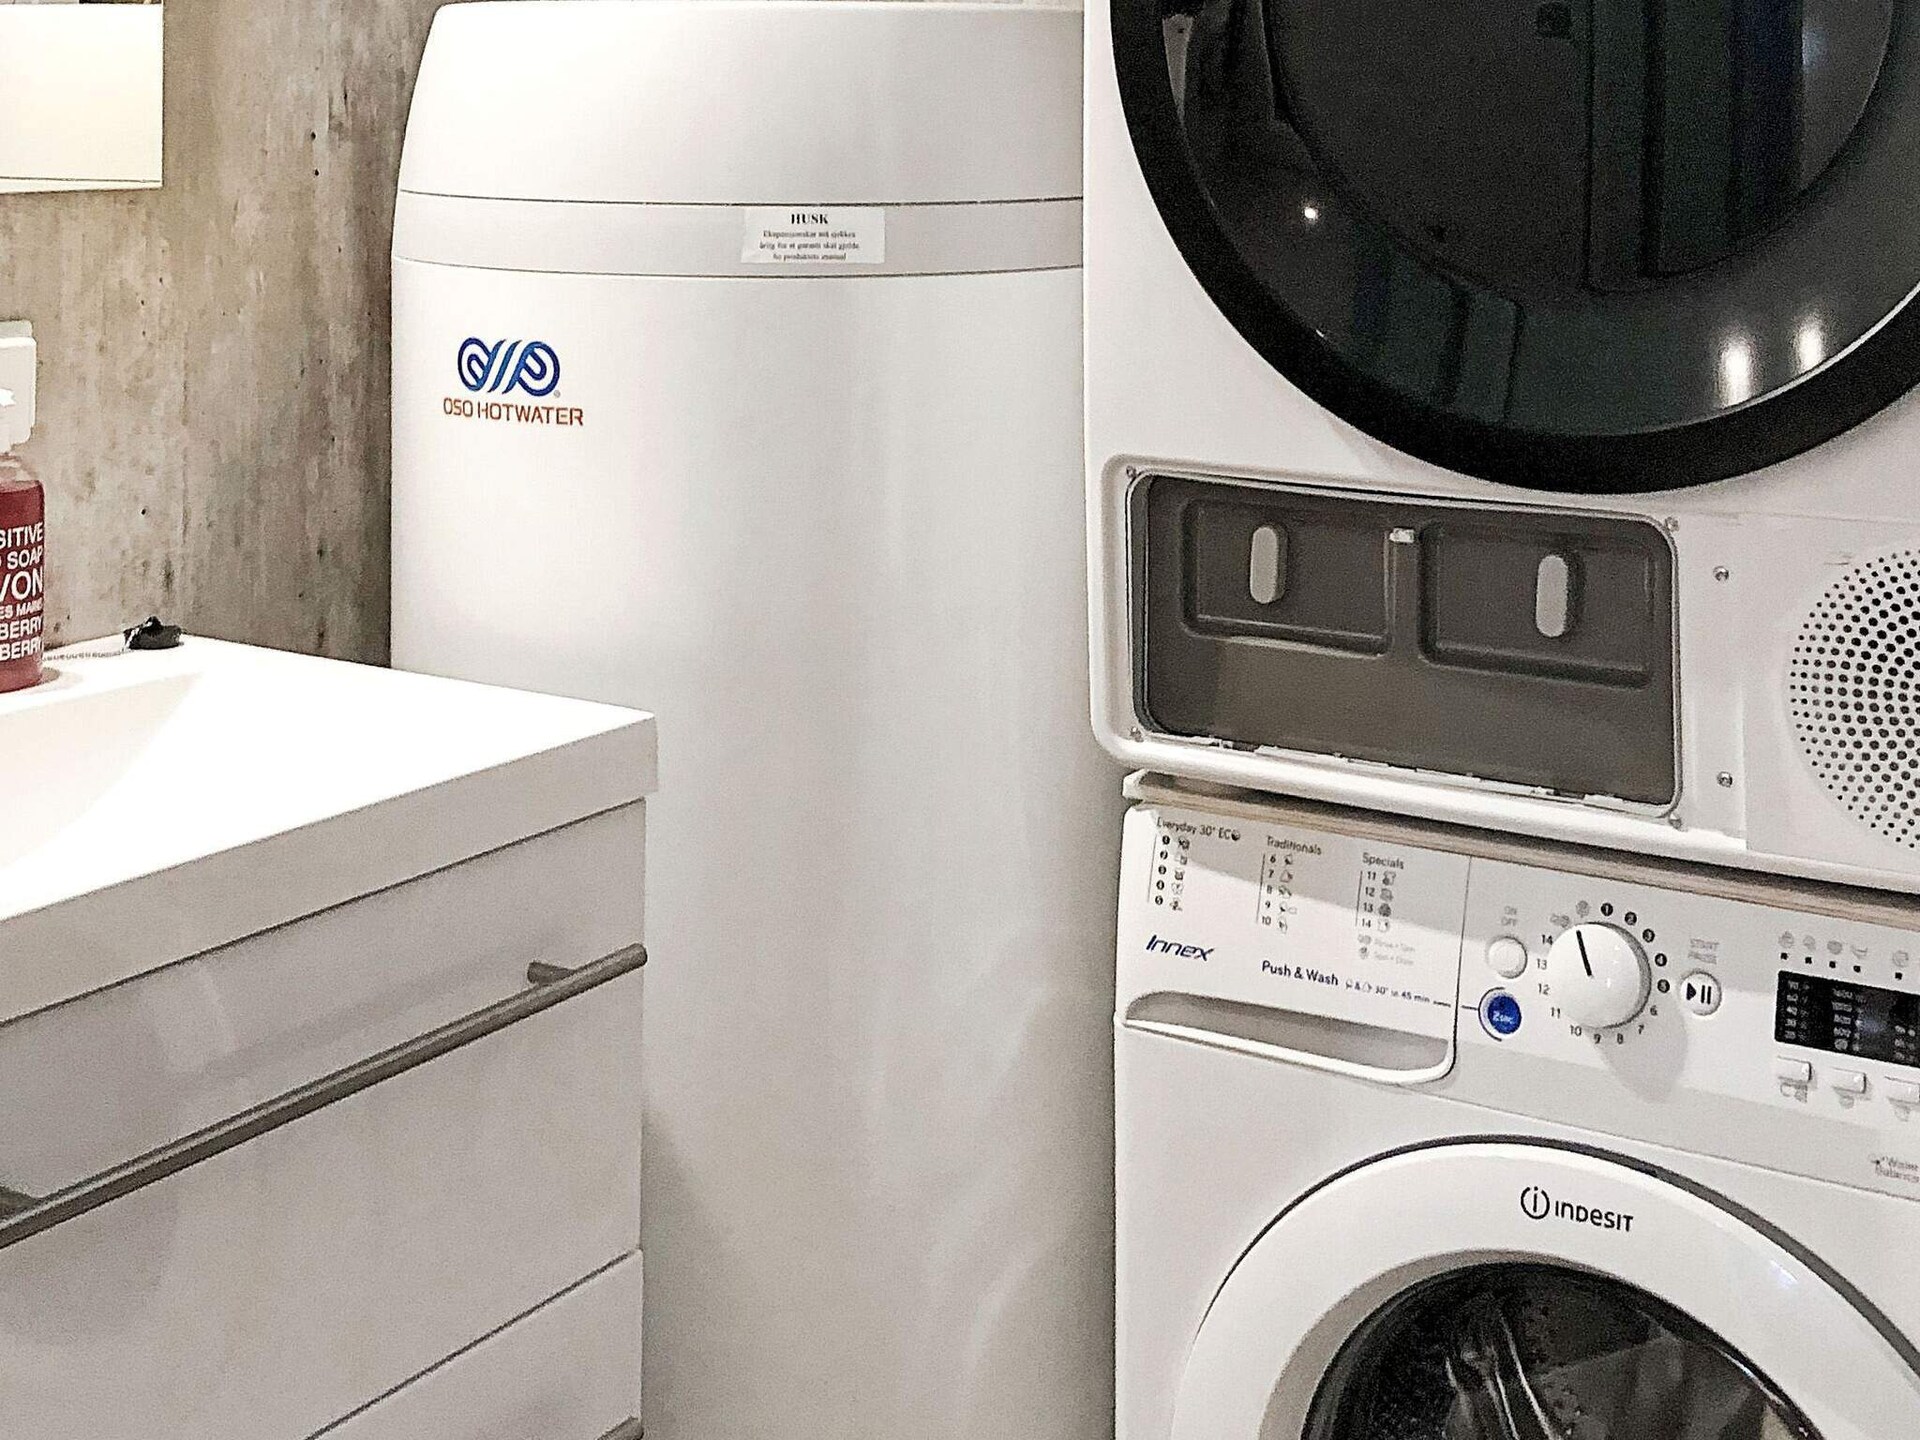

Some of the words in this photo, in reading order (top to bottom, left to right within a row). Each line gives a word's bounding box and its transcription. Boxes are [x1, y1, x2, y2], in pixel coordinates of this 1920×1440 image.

[790, 213, 829, 225] HUSK
[443, 397, 473, 417] OSO
[477, 401, 584, 427] HOTWATER
[7, 545, 43, 570] SOAP
[1266, 835, 1322, 856] Traditionals
[1362, 852, 1404, 870] Specials
[1367, 870, 1377, 881] 11
[1365, 886, 1375, 897] 12
[1363, 902, 1374, 913] 13
[1261, 915, 1272, 926] 10
[1361, 917, 1372, 928] 14
[1541, 934, 1553, 946] 14
[1146, 934, 1214, 962] Innex
[1537, 958, 1548, 970] 13
[1262, 959, 1292, 978] Push
[1294, 967, 1304, 980] &
[1306, 968, 1339, 986] Wash
[1538, 983, 1550, 996] 12
[1551, 1007, 1562, 1019] 11
[1570, 1024, 1582, 1037] 10
[1638, 1024, 1645, 1035] 7
[1594, 1033, 1602, 1045] 9
[1616, 1032, 1624, 1045] 8
